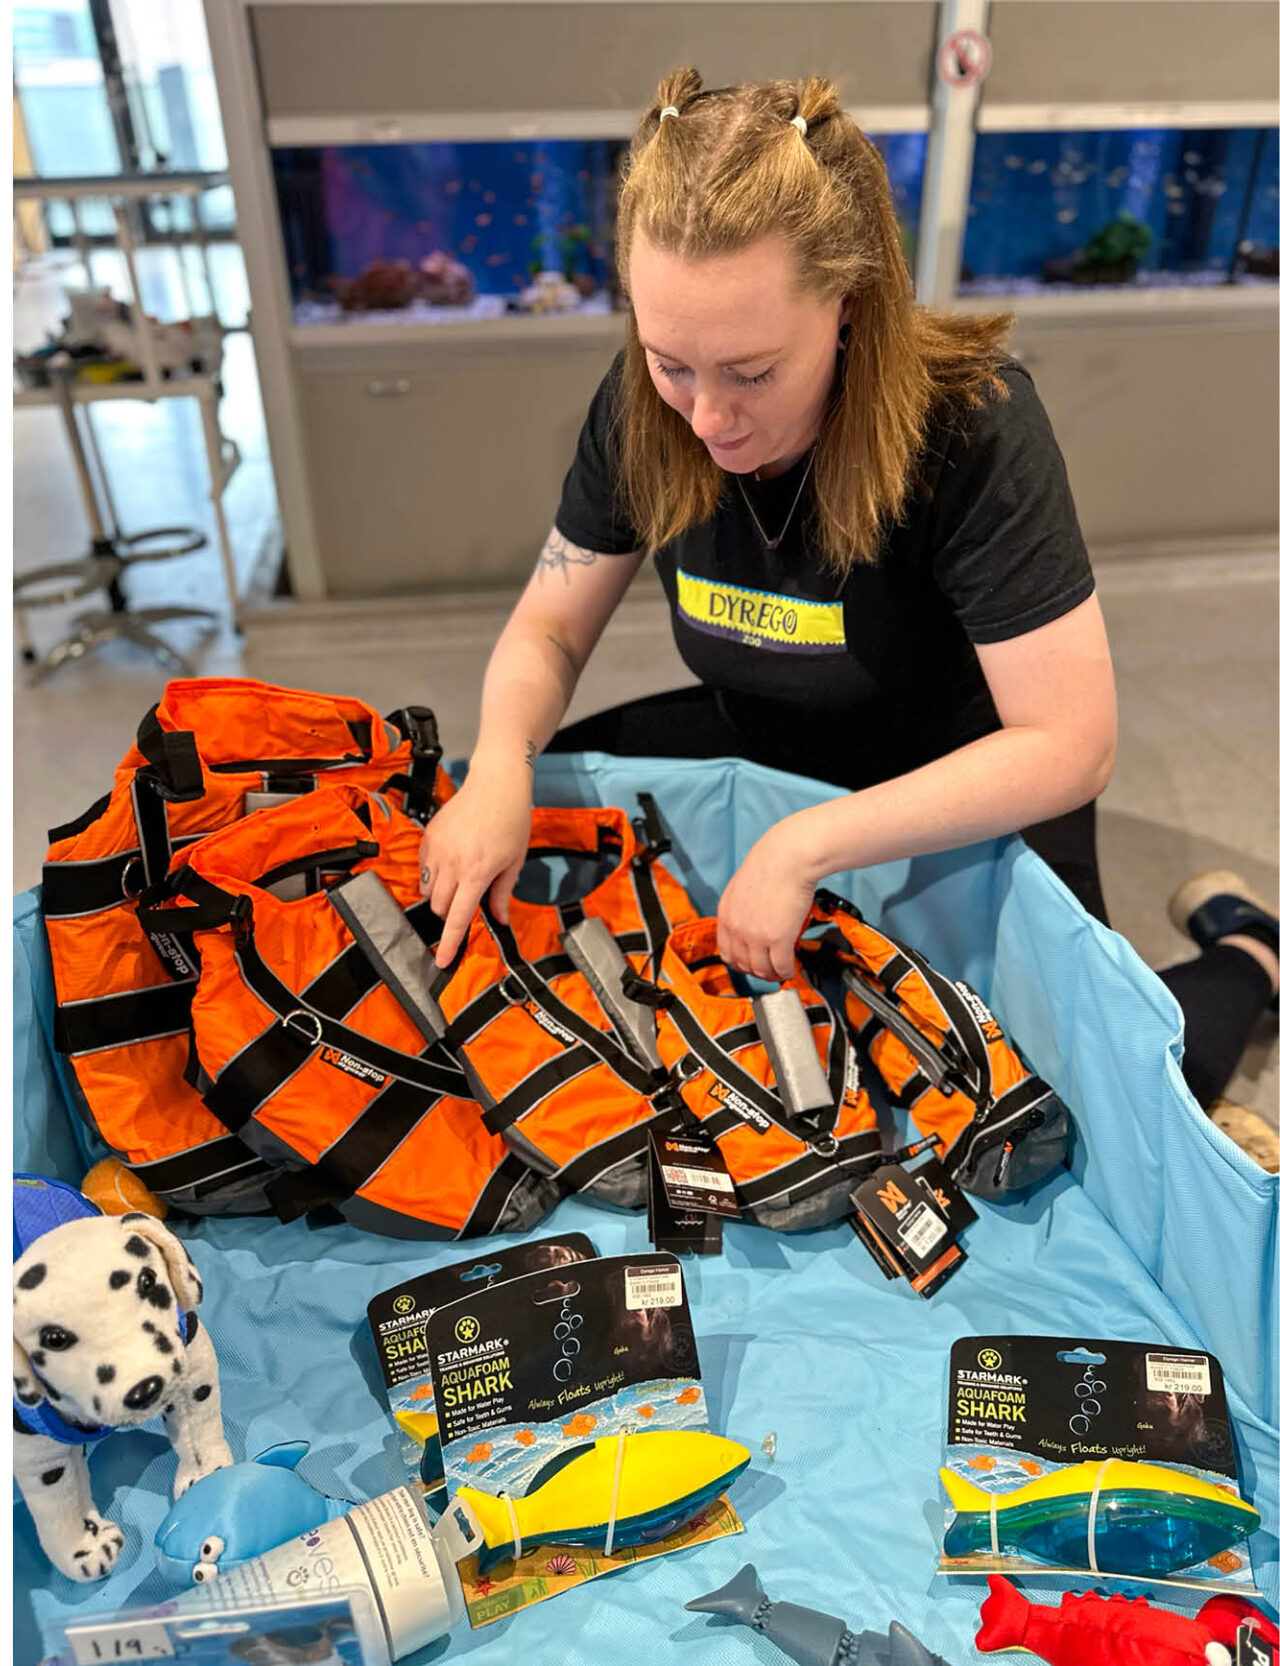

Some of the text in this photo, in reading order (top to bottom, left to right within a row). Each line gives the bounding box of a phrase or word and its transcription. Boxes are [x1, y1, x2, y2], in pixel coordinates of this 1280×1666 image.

[708, 592, 798, 636] DYREGO
[339, 1054, 385, 1082] Non-stop
[727, 1092, 770, 1128] Non-stop
[650, 1296, 675, 1306] 219.00
[437, 1337, 504, 1365] STARMARK
[441, 1356, 510, 1388] AQUAFOAM
[957, 1369, 1022, 1385] STARMARK
[443, 1370, 514, 1407] SHARK
[528, 1398, 555, 1411] Always
[557, 1383, 592, 1405] Floats
[956, 1386, 1026, 1404] AQUAFOAM
[1165, 1382, 1203, 1392] kr 219.00
[451, 1396, 505, 1416] Made for Water Play
[453, 1404, 512, 1427] Safe for Teeth & Gums
[956, 1399, 1027, 1423] SHARK
[481, 1416, 507, 1428] Materials
[961, 1418, 977, 1426] Made
[986, 1421, 1002, 1429] Water
[1002, 1423, 1015, 1431] Play
[961, 1427, 974, 1435] Safe
[983, 1430, 999, 1438] Teeth
[1005, 1432, 1022, 1440] Gums
[988, 1439, 1015, 1447] Materials
[1038, 1438, 1067, 1454] Always
[1071, 1442, 1108, 1454] Floats
[477, 1600, 510, 1620] PLAY
